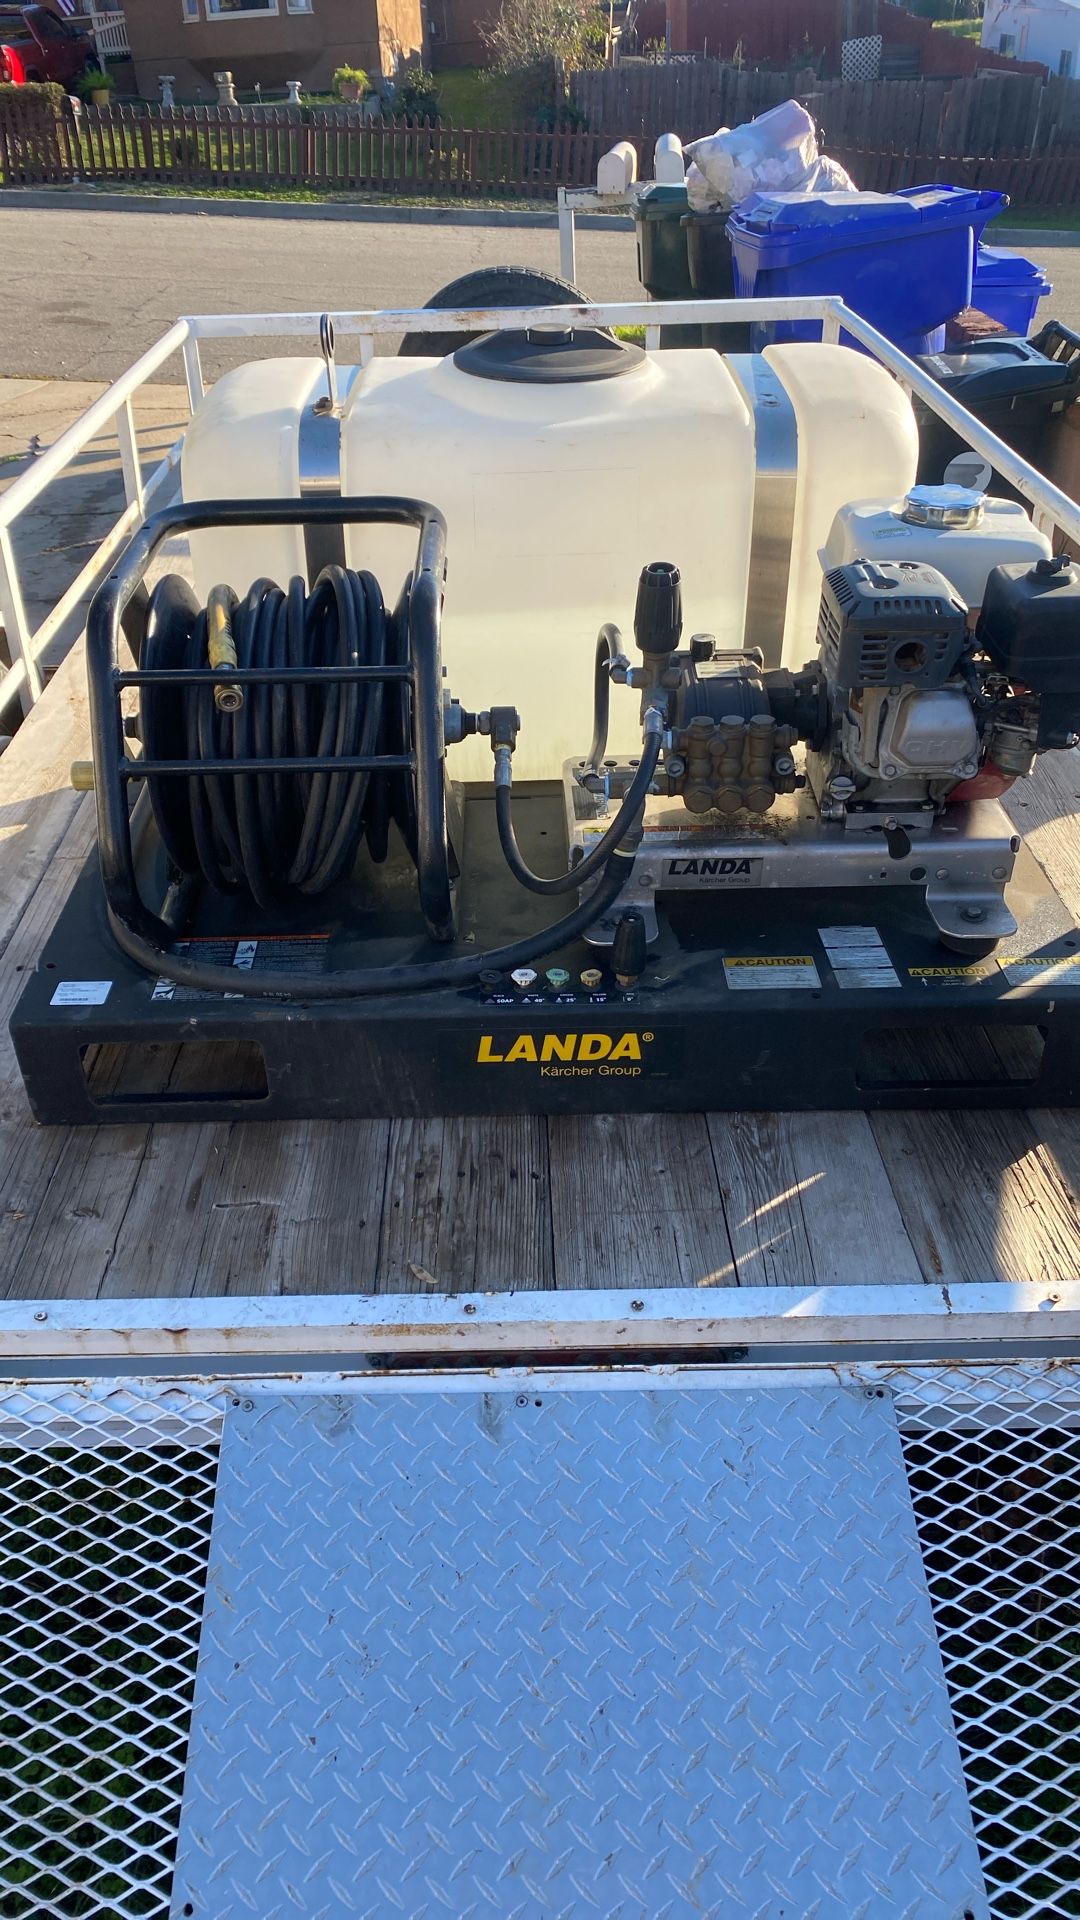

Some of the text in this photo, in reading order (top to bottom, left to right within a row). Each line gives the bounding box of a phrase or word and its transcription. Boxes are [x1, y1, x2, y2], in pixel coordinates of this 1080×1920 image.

[668, 860, 751, 875] LANDA
[745, 958, 807, 966] CAUTION
[1011, 958, 1076, 966] CAUTION
[921, 967, 987, 976] CAUTION
[541, 1065, 641, 1077] Kärcher Group
